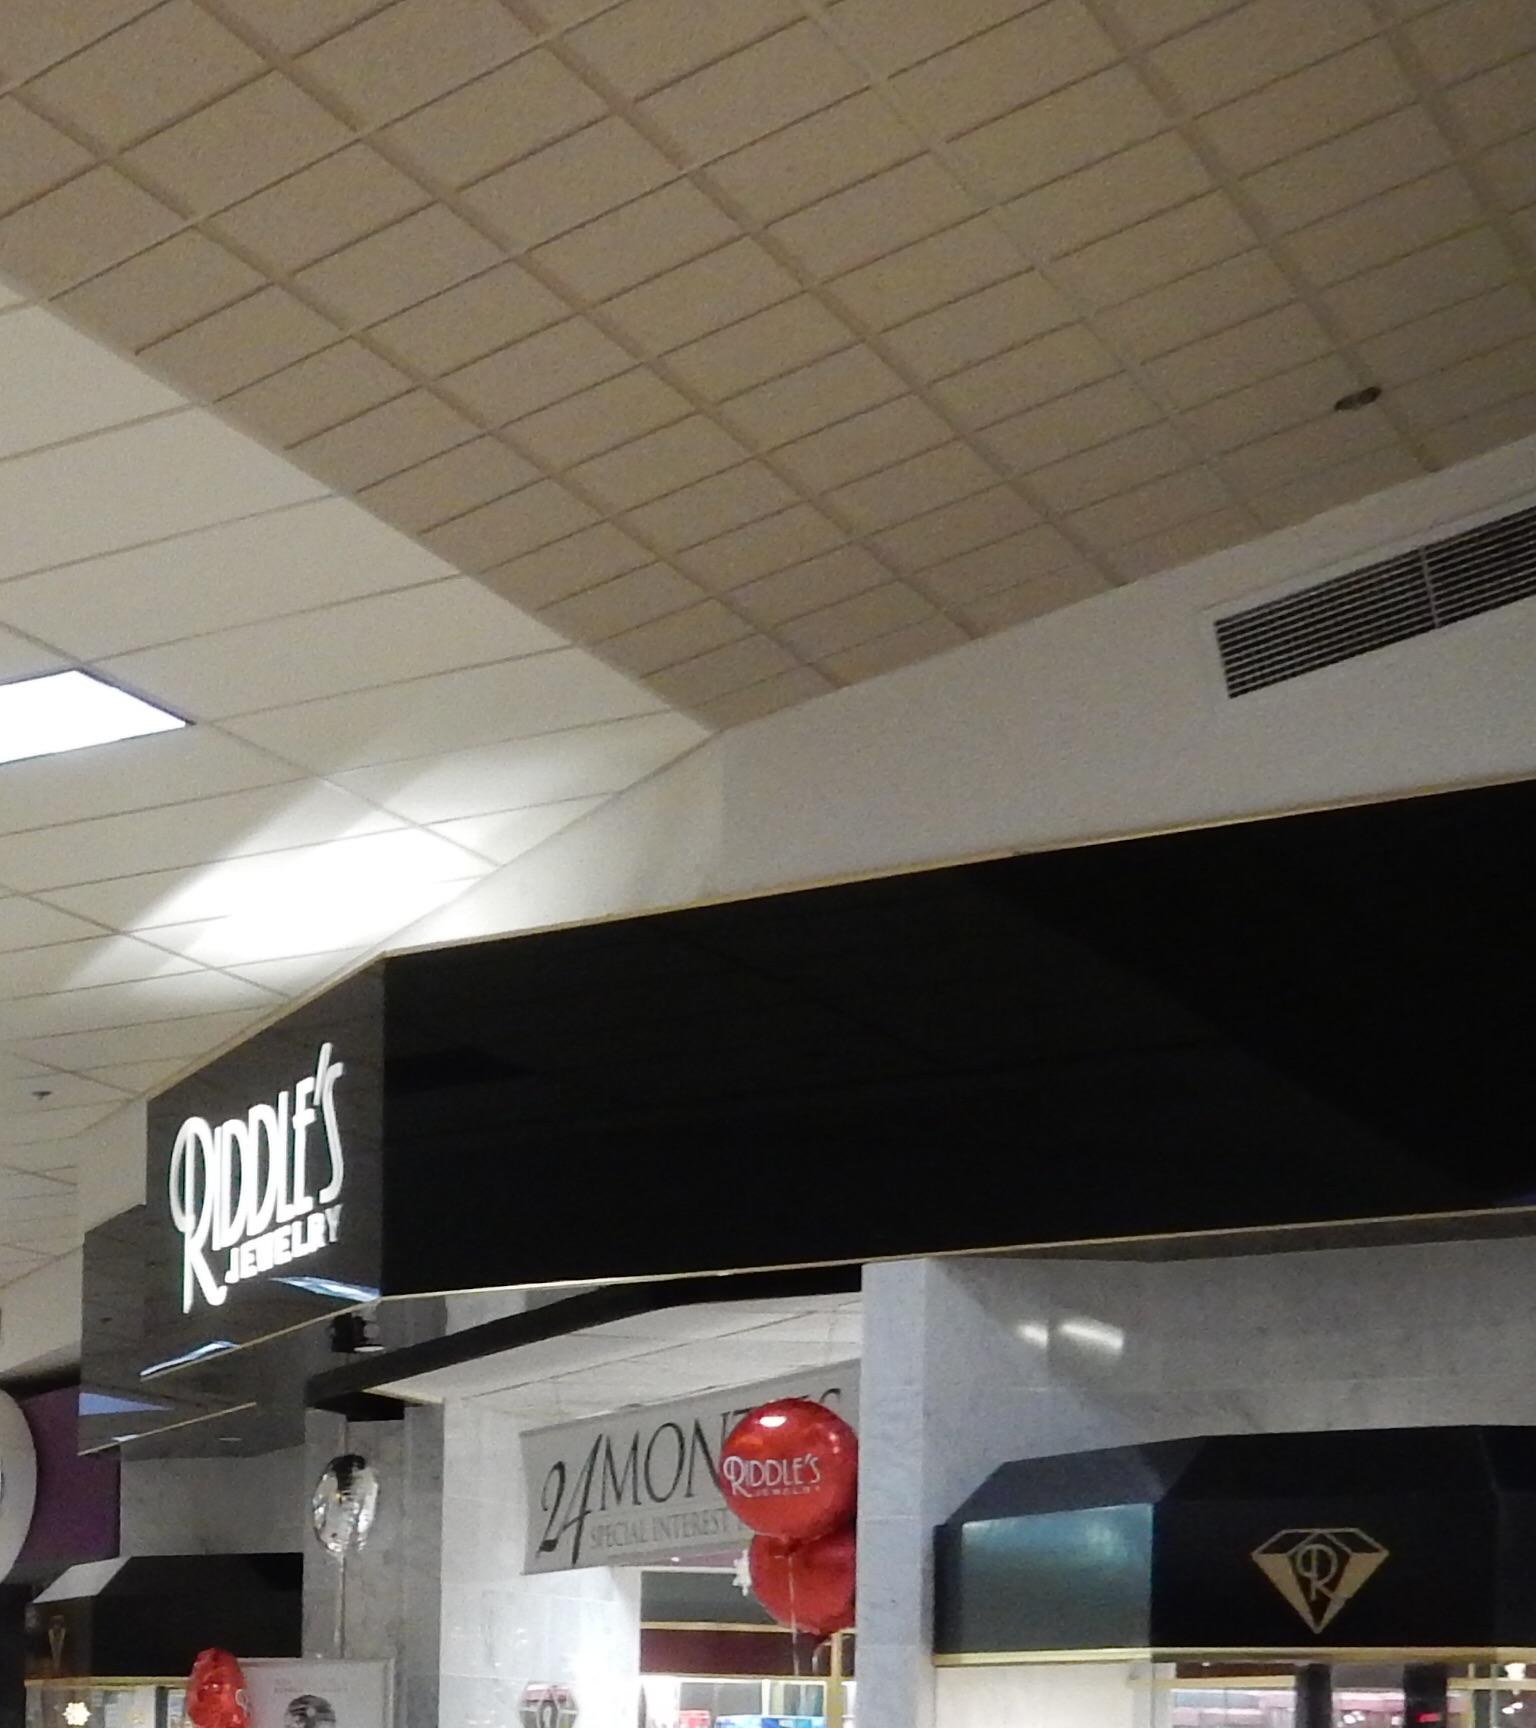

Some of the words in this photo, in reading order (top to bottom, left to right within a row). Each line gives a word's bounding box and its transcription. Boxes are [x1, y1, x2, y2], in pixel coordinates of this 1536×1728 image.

[169, 1042, 344, 1314] RIDDLE'S
[225, 1203, 343, 1284] JEWELRY
[536, 1433, 603, 1565] 24
[723, 1453, 822, 1498] RIDDLE'S
[591, 1519, 648, 1549] SPECIAL
[652, 1507, 728, 1542] INTEREST
